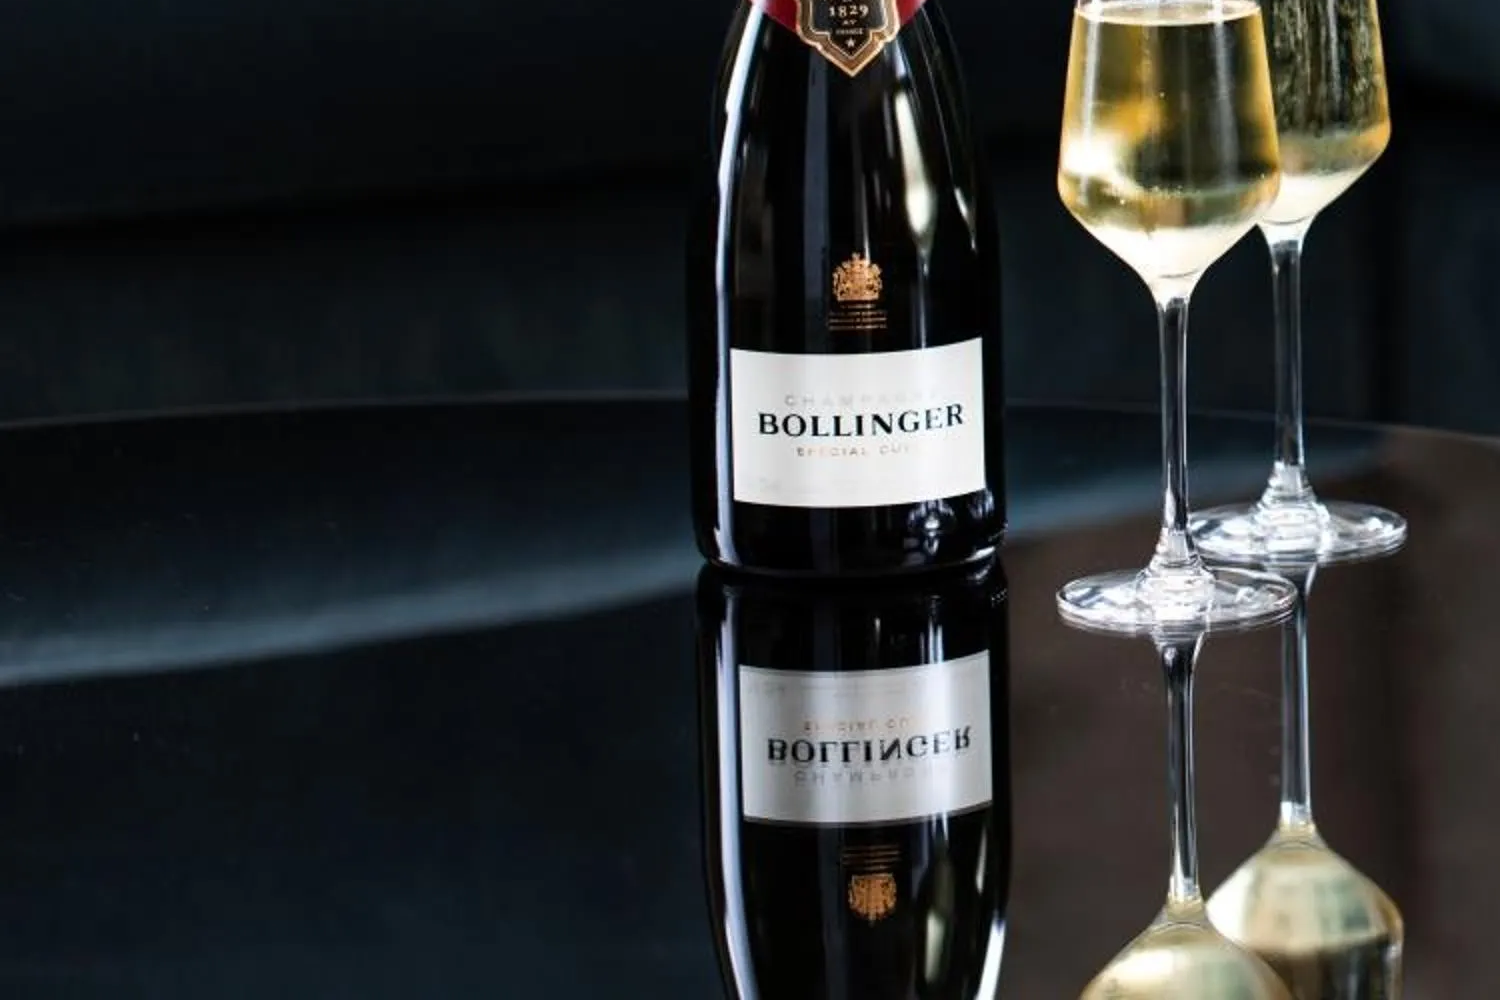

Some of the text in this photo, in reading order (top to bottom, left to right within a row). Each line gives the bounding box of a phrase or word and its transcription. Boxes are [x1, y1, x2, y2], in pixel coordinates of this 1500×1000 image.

[828, 4, 869, 18] 1829
[784, 391, 937, 407] CHAMPAG
[758, 403, 965, 438] BOLLINGER
